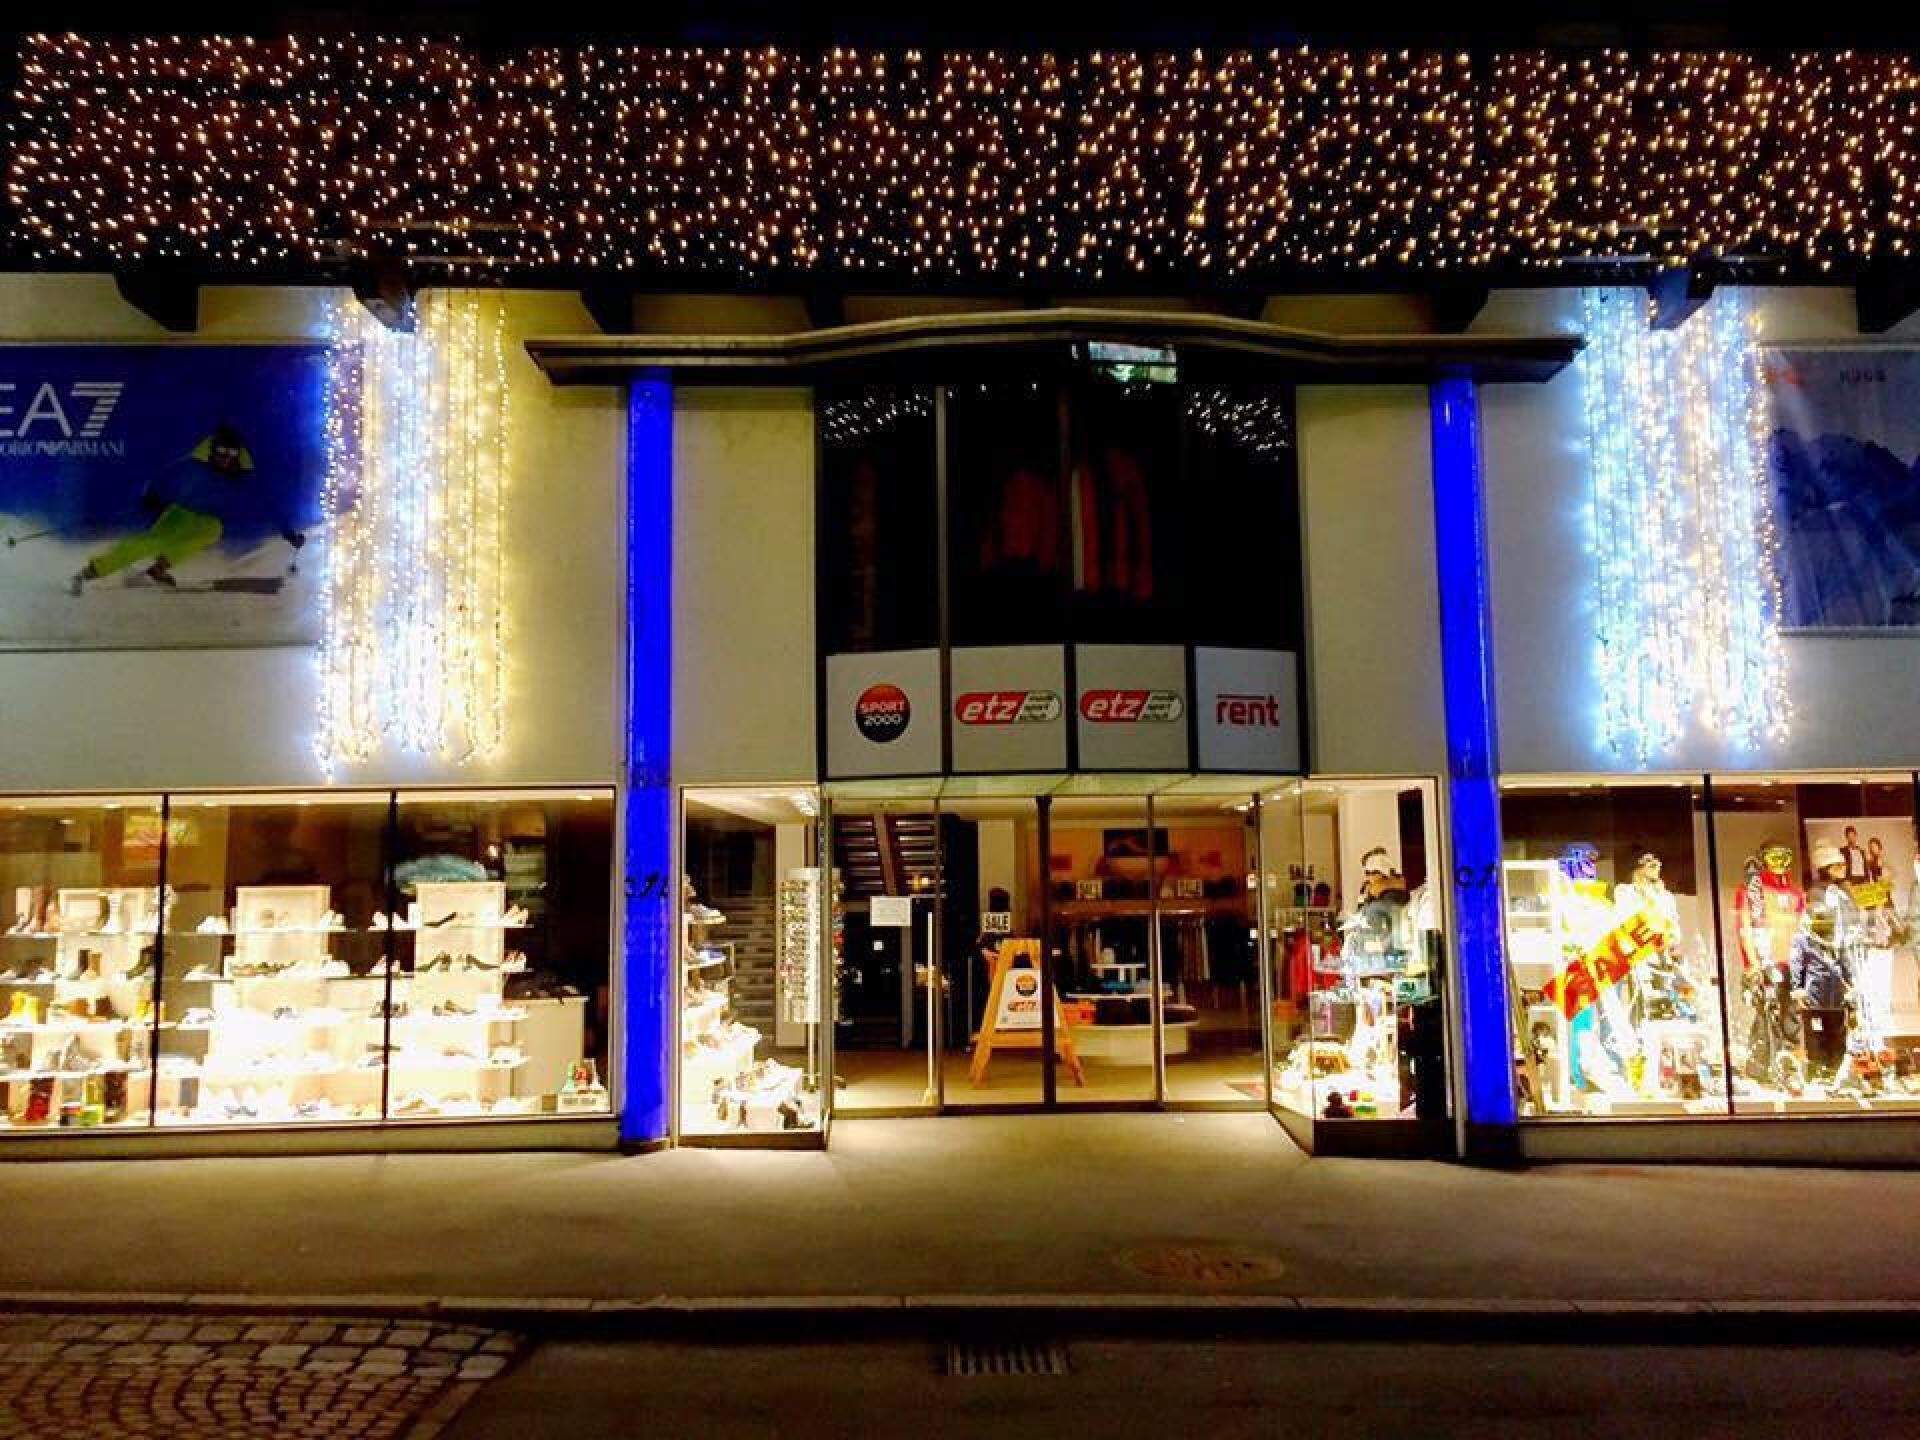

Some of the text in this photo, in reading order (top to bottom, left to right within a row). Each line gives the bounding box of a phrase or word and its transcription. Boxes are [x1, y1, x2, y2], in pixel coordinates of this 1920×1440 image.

[860, 701, 904, 713] SPORT
[962, 694, 1018, 721] etz
[1088, 691, 1142, 719] etz
[1216, 694, 1279, 726] rent
[864, 714, 902, 726] 2000
